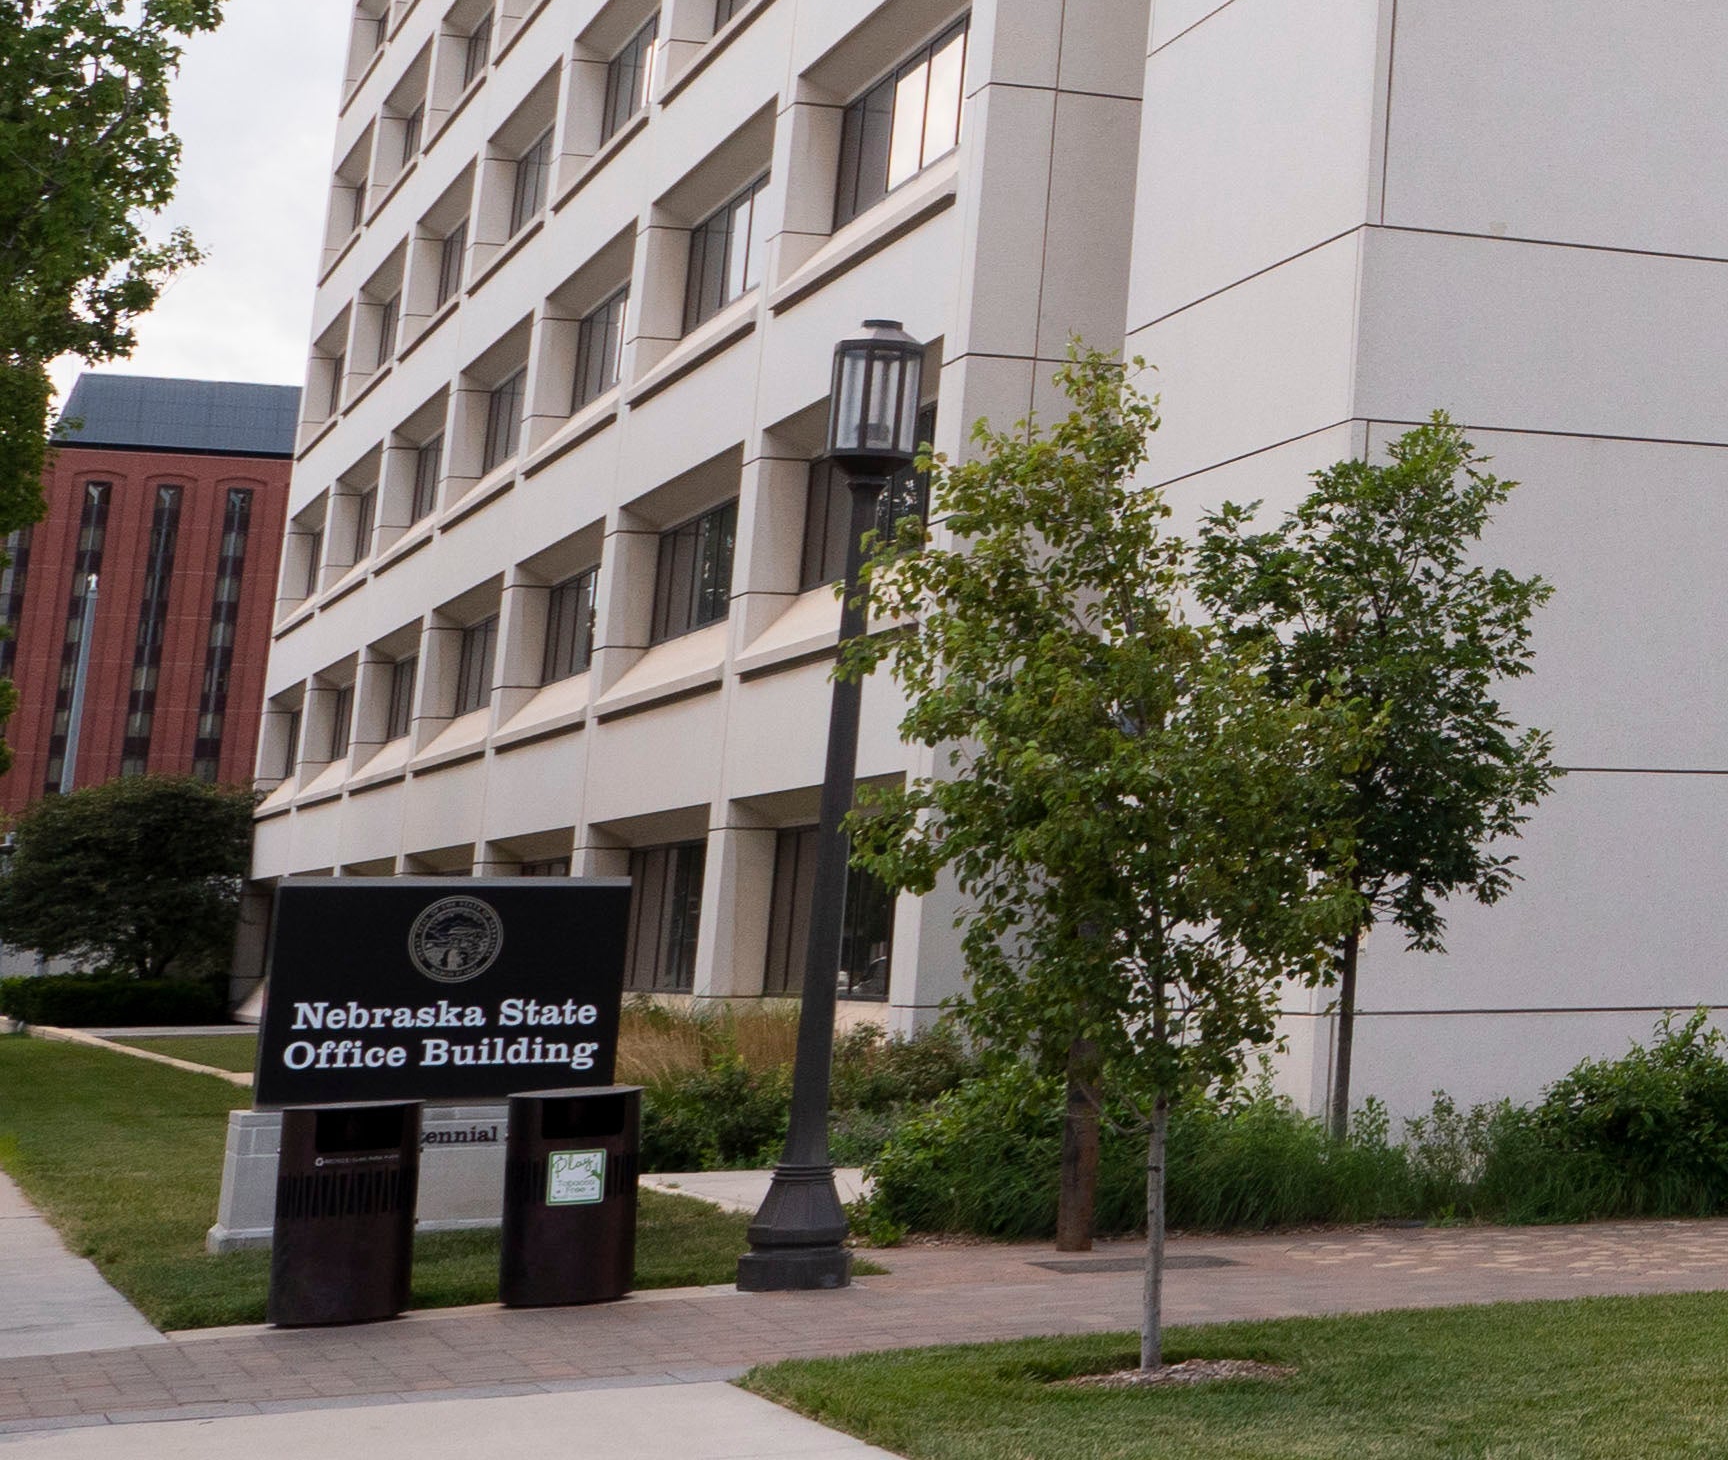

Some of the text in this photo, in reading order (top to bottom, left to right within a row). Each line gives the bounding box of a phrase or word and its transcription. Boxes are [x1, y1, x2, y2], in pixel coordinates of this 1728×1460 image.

[290, 997, 598, 1030] Nebraska State
[283, 1037, 599, 1071] Office Building
